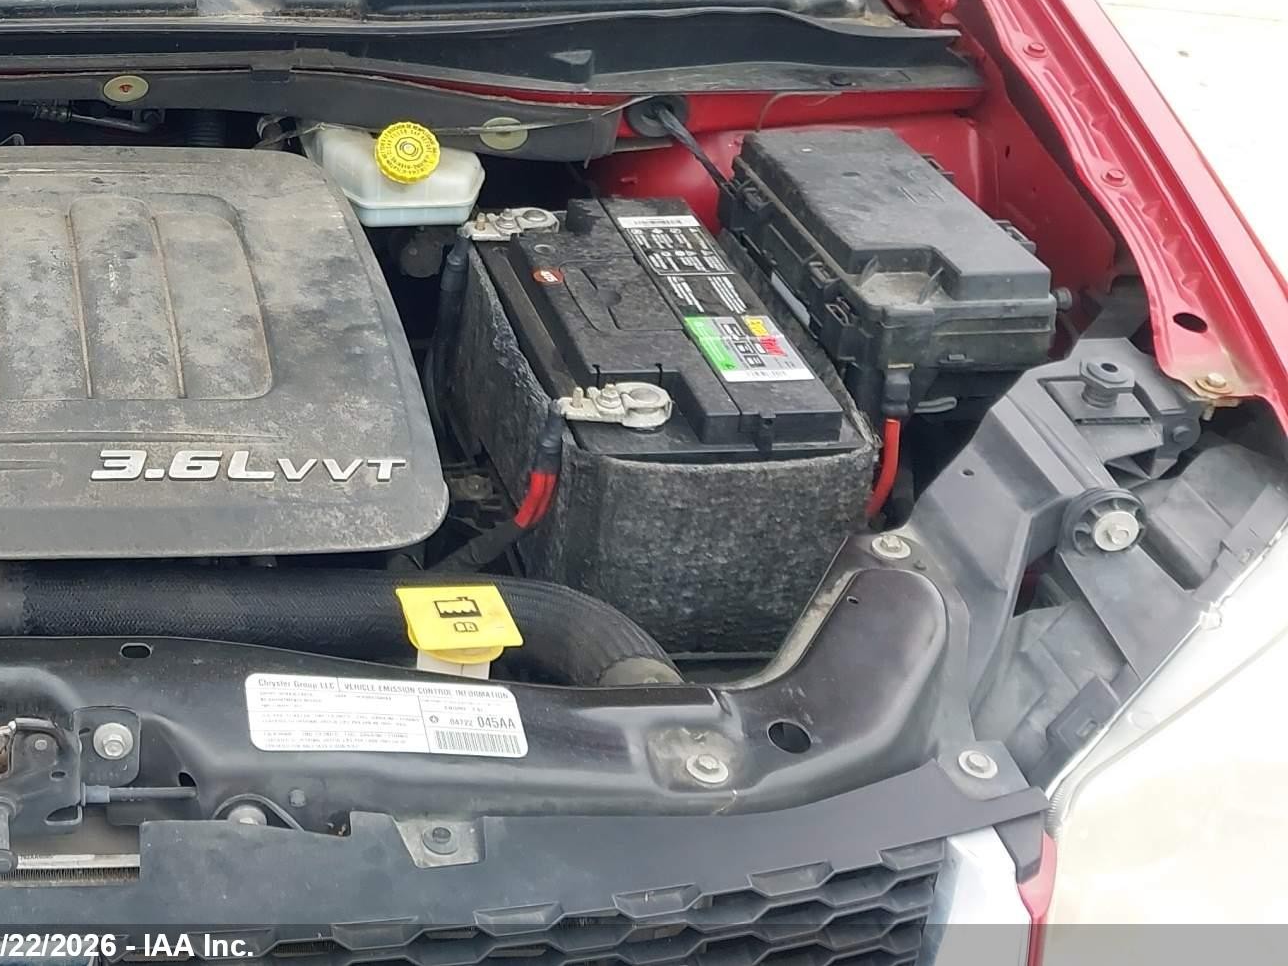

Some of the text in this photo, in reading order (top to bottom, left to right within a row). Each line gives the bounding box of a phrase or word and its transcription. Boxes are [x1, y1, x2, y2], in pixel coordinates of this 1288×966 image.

[258, 678, 334, 690] Chrysler Group LLC
[344, 683, 509, 699] VEHICLE EMISSION CONTROL INFORMATION
[477, 715, 517, 730] 045AA
